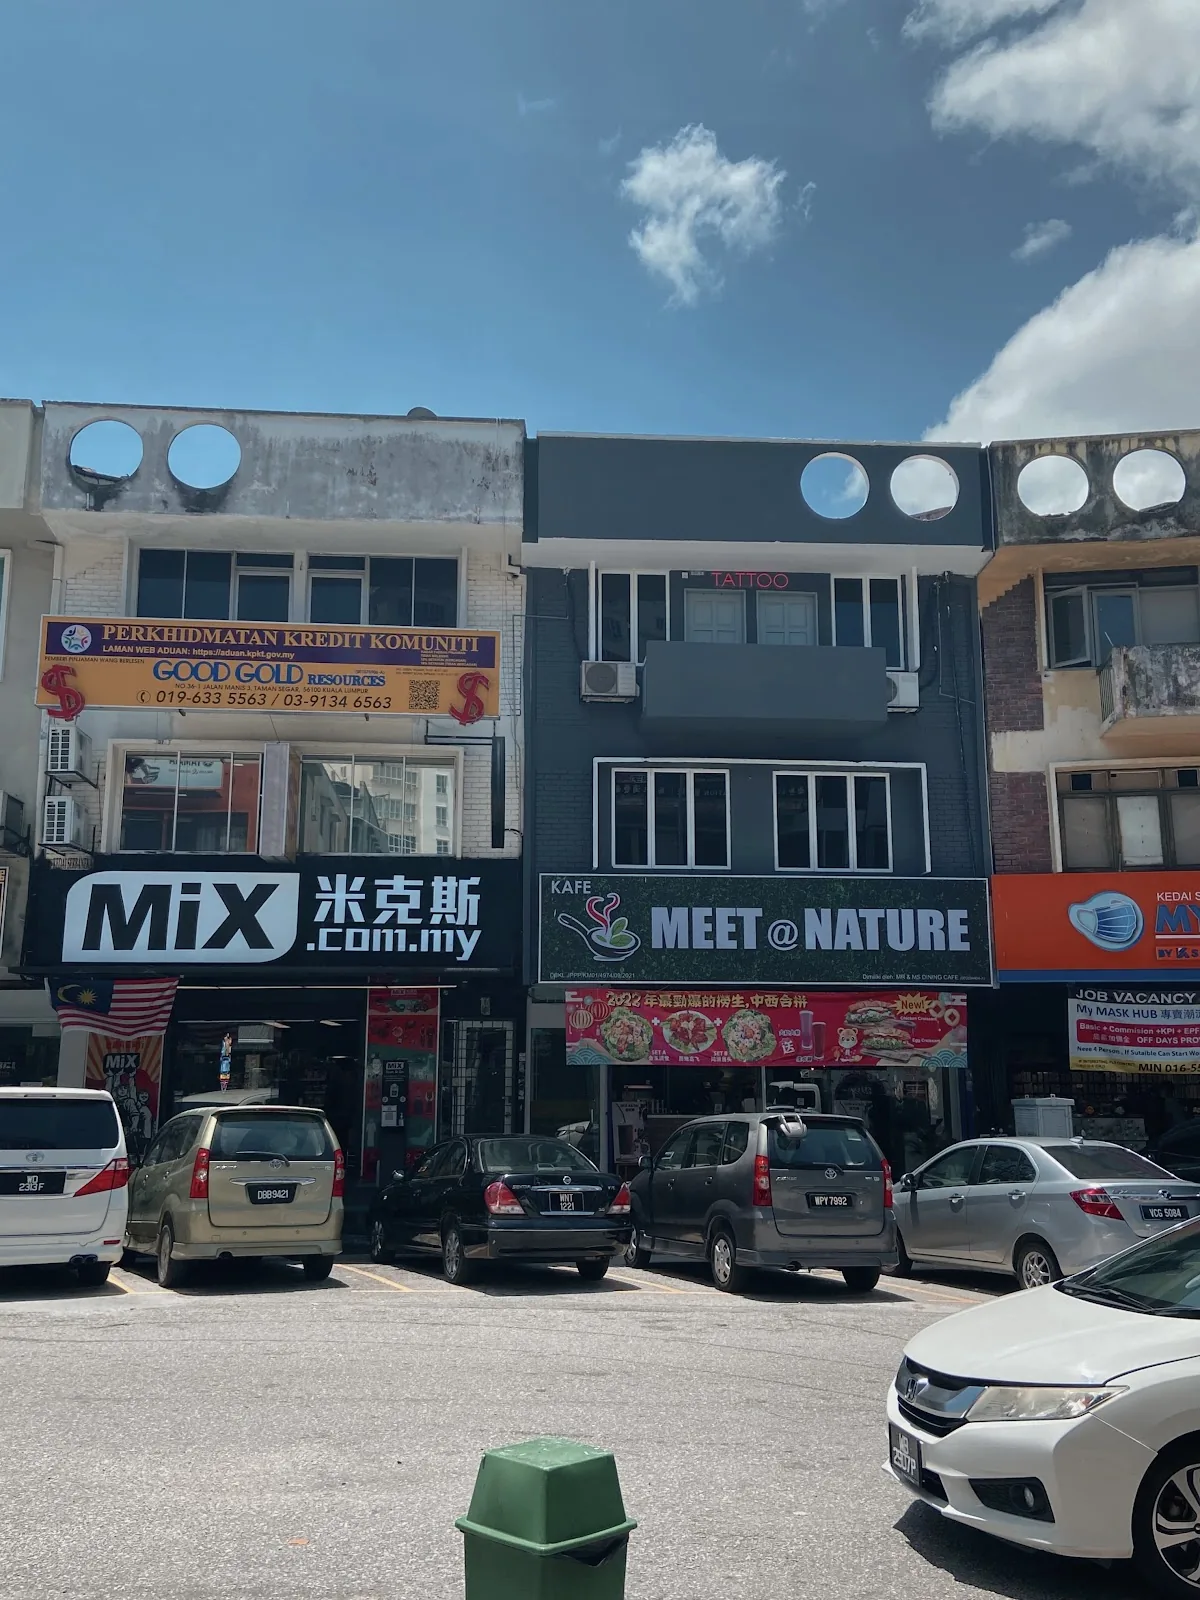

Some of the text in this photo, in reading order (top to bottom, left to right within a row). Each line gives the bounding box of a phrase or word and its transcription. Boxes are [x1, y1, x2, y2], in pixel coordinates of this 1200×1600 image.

[711, 572, 789, 588] TATTOO
[101, 625, 479, 652] PERKHIDMATAN KREDIT KOMUNITI
[102, 645, 295, 659] LAMAN WEB ADUAN: https://aduan.kpkt.gov.my
[153, 659, 386, 687] GOOD GOLD RESOURCES
[156, 690, 221, 704] 019-633
[227, 693, 267, 705] 5563
[283, 694, 348, 708] 03-9134
[353, 696, 392, 709] 6563
[551, 880, 592, 895] KAFE
[314, 873, 481, 926] 米克斯
[1156, 891, 1192, 901] KEDAI
[81, 882, 280, 951] MiX
[651, 906, 971, 951] MEET @ NATURE
[306, 928, 482, 961] .com.my
[606, 992, 642, 1007] 2022
[1075, 989, 1197, 1004] JOB VACANCY
[900, 1001, 925, 1011] New!
[1076, 1003, 1093, 1015] My
[1096, 1007, 1130, 1018] MASK
[1132, 1009, 1158, 1019] HUB
[1079, 1023, 1101, 1031] Basic
[1109, 1025, 1154, 1035] Commision
[1136, 1036, 1153, 1044] OFF
[1155, 1036, 1178, 1044] DAYS
[1180, 1036, 1200, 1044] PRO
[105, 1054, 138, 1069] MiX
[1138, 1063, 1162, 1073] MIN
[559, 1193, 574, 1202] WNT
[814, 1196, 848, 1206] WPY 7992
[559, 1202, 575, 1211] 1221
[1149, 1208, 1163, 1218] VCG
